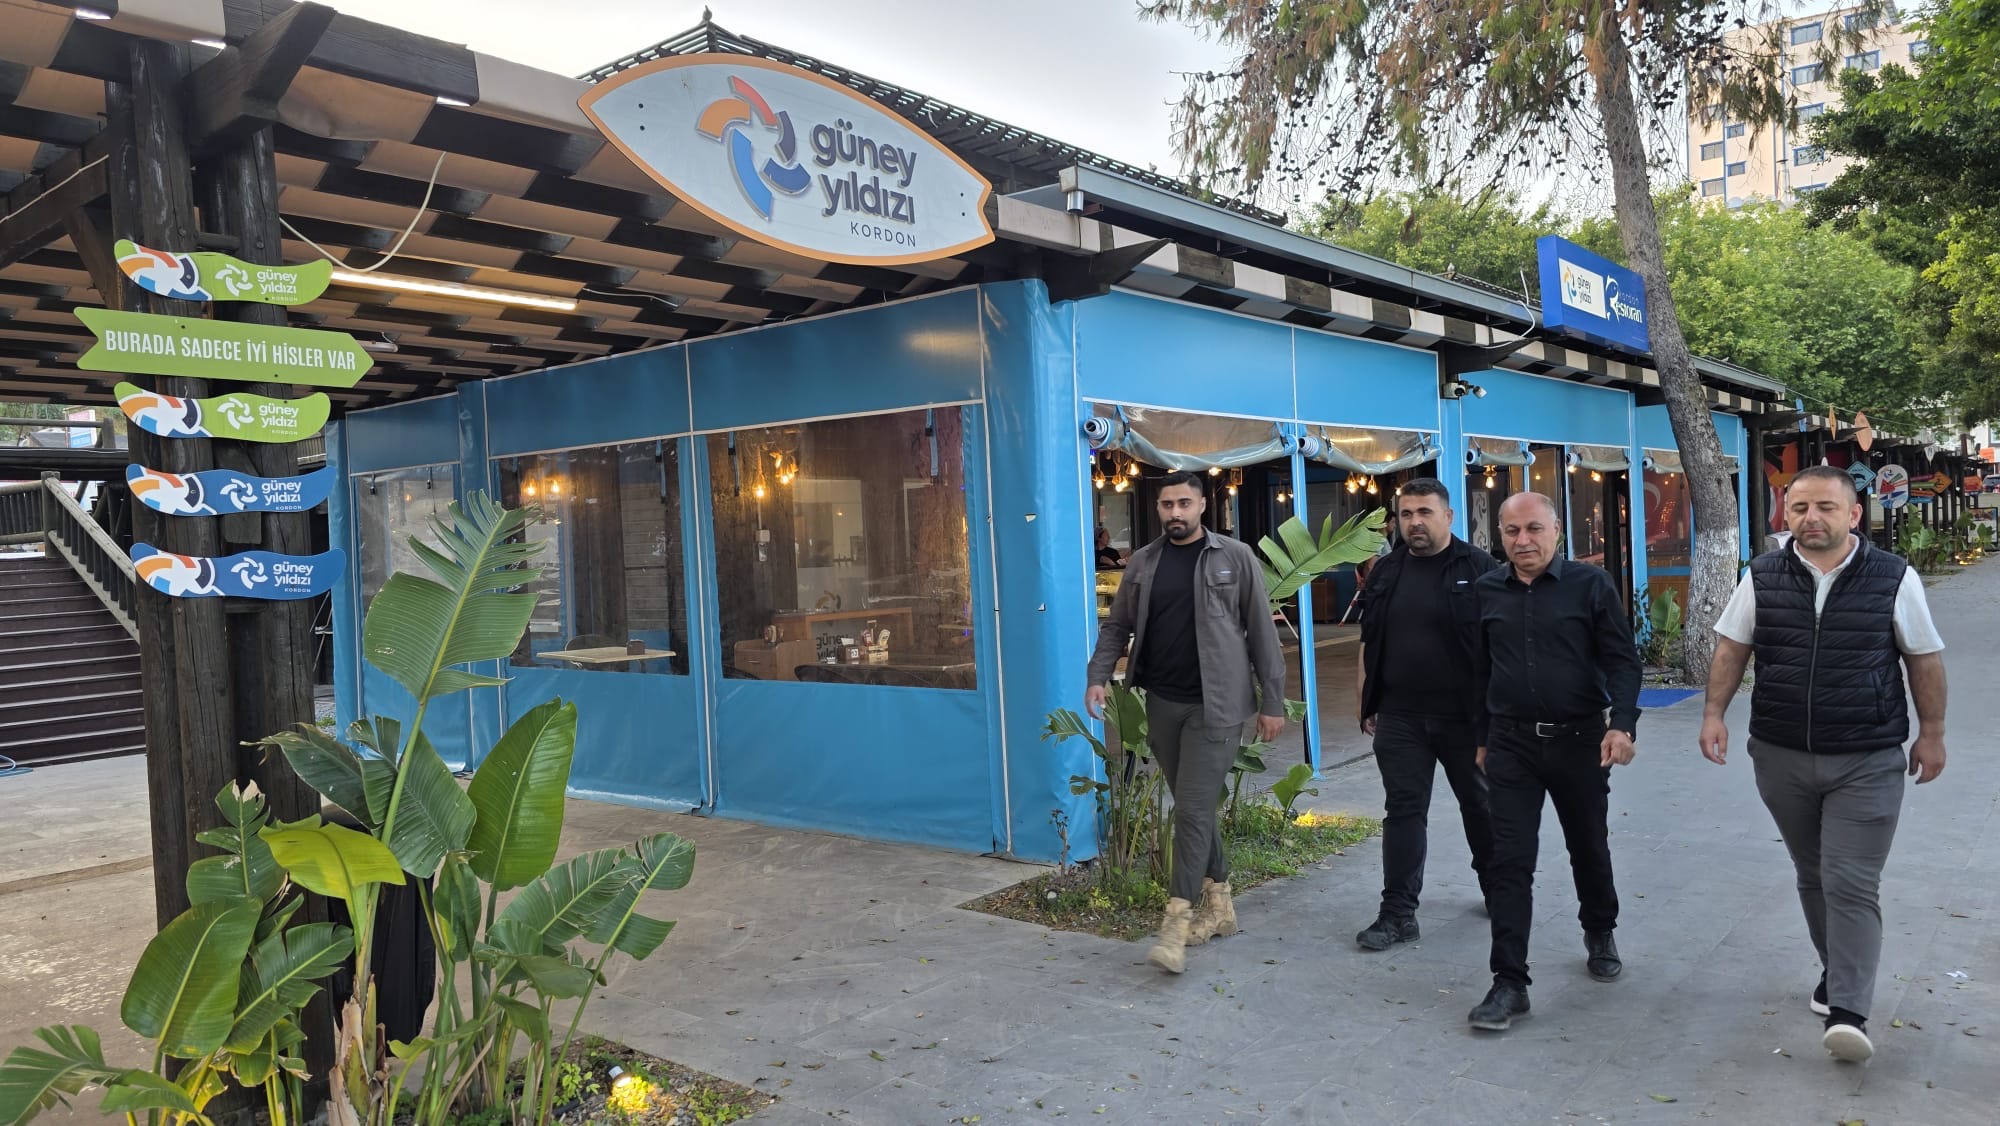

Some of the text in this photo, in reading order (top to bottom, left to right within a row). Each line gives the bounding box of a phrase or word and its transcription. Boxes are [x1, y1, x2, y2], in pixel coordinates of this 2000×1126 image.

[810, 118, 917, 188] güney
[818, 171, 916, 225] yıldızı
[850, 221, 916, 247] KORDON
[256, 268, 298, 285] güney
[260, 281, 297, 295] yıldızı
[105, 329, 356, 371] BURADA SADECE İYİ HİSLER VAR
[258, 402, 299, 418] güney
[261, 415, 297, 428] yıldızı
[261, 479, 302, 494] güney
[264, 491, 301, 506] yıldızı
[272, 560, 314, 576] güney
[274, 573, 311, 587] yıldızı
